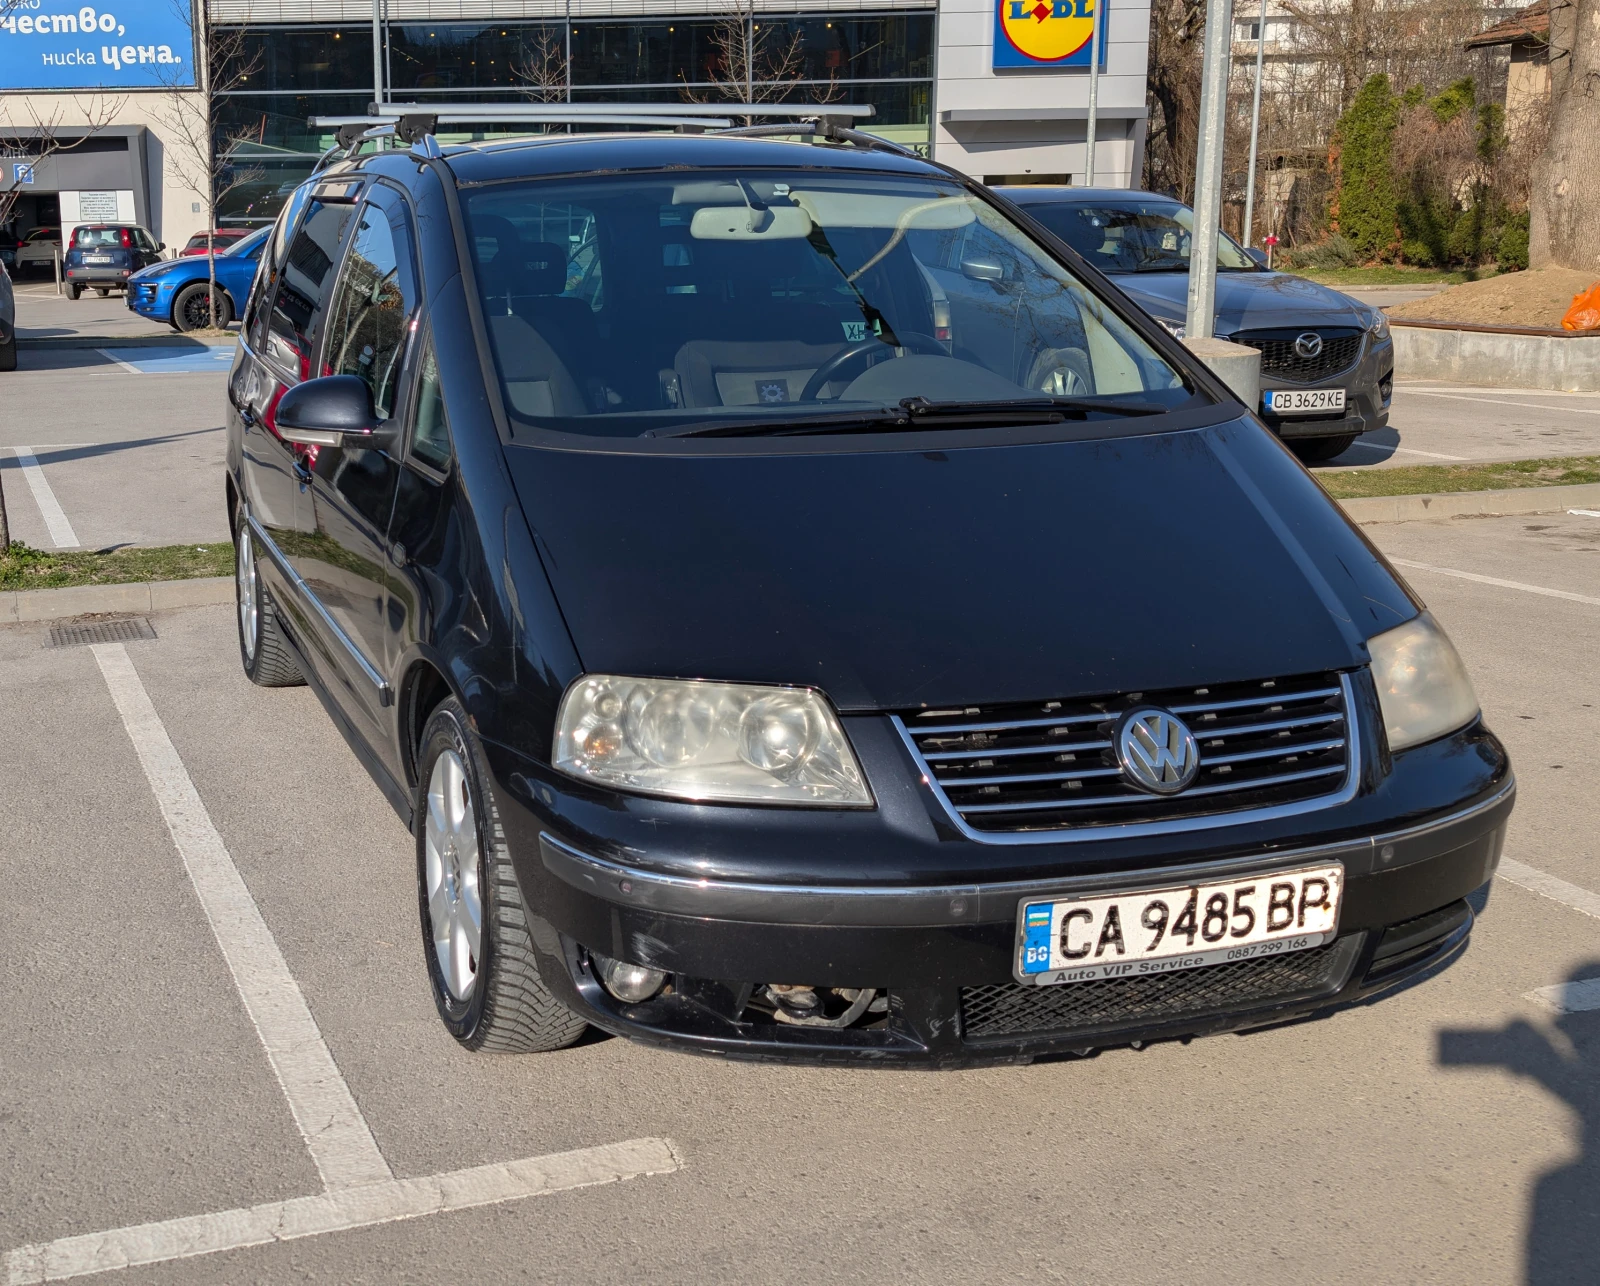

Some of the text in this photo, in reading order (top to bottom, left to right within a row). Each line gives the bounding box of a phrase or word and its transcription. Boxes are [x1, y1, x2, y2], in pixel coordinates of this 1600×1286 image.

[1008, 0, 1093, 24] LIDL
[42, 45, 182, 70] ниска цена.
[1274, 392, 1343, 408] CB 3629 KE
[1060, 876, 1331, 961] CA 9485 BP
[1026, 945, 1048, 964] BG
[1054, 937, 1308, 982] Auto VIP Service 0887 299 166
